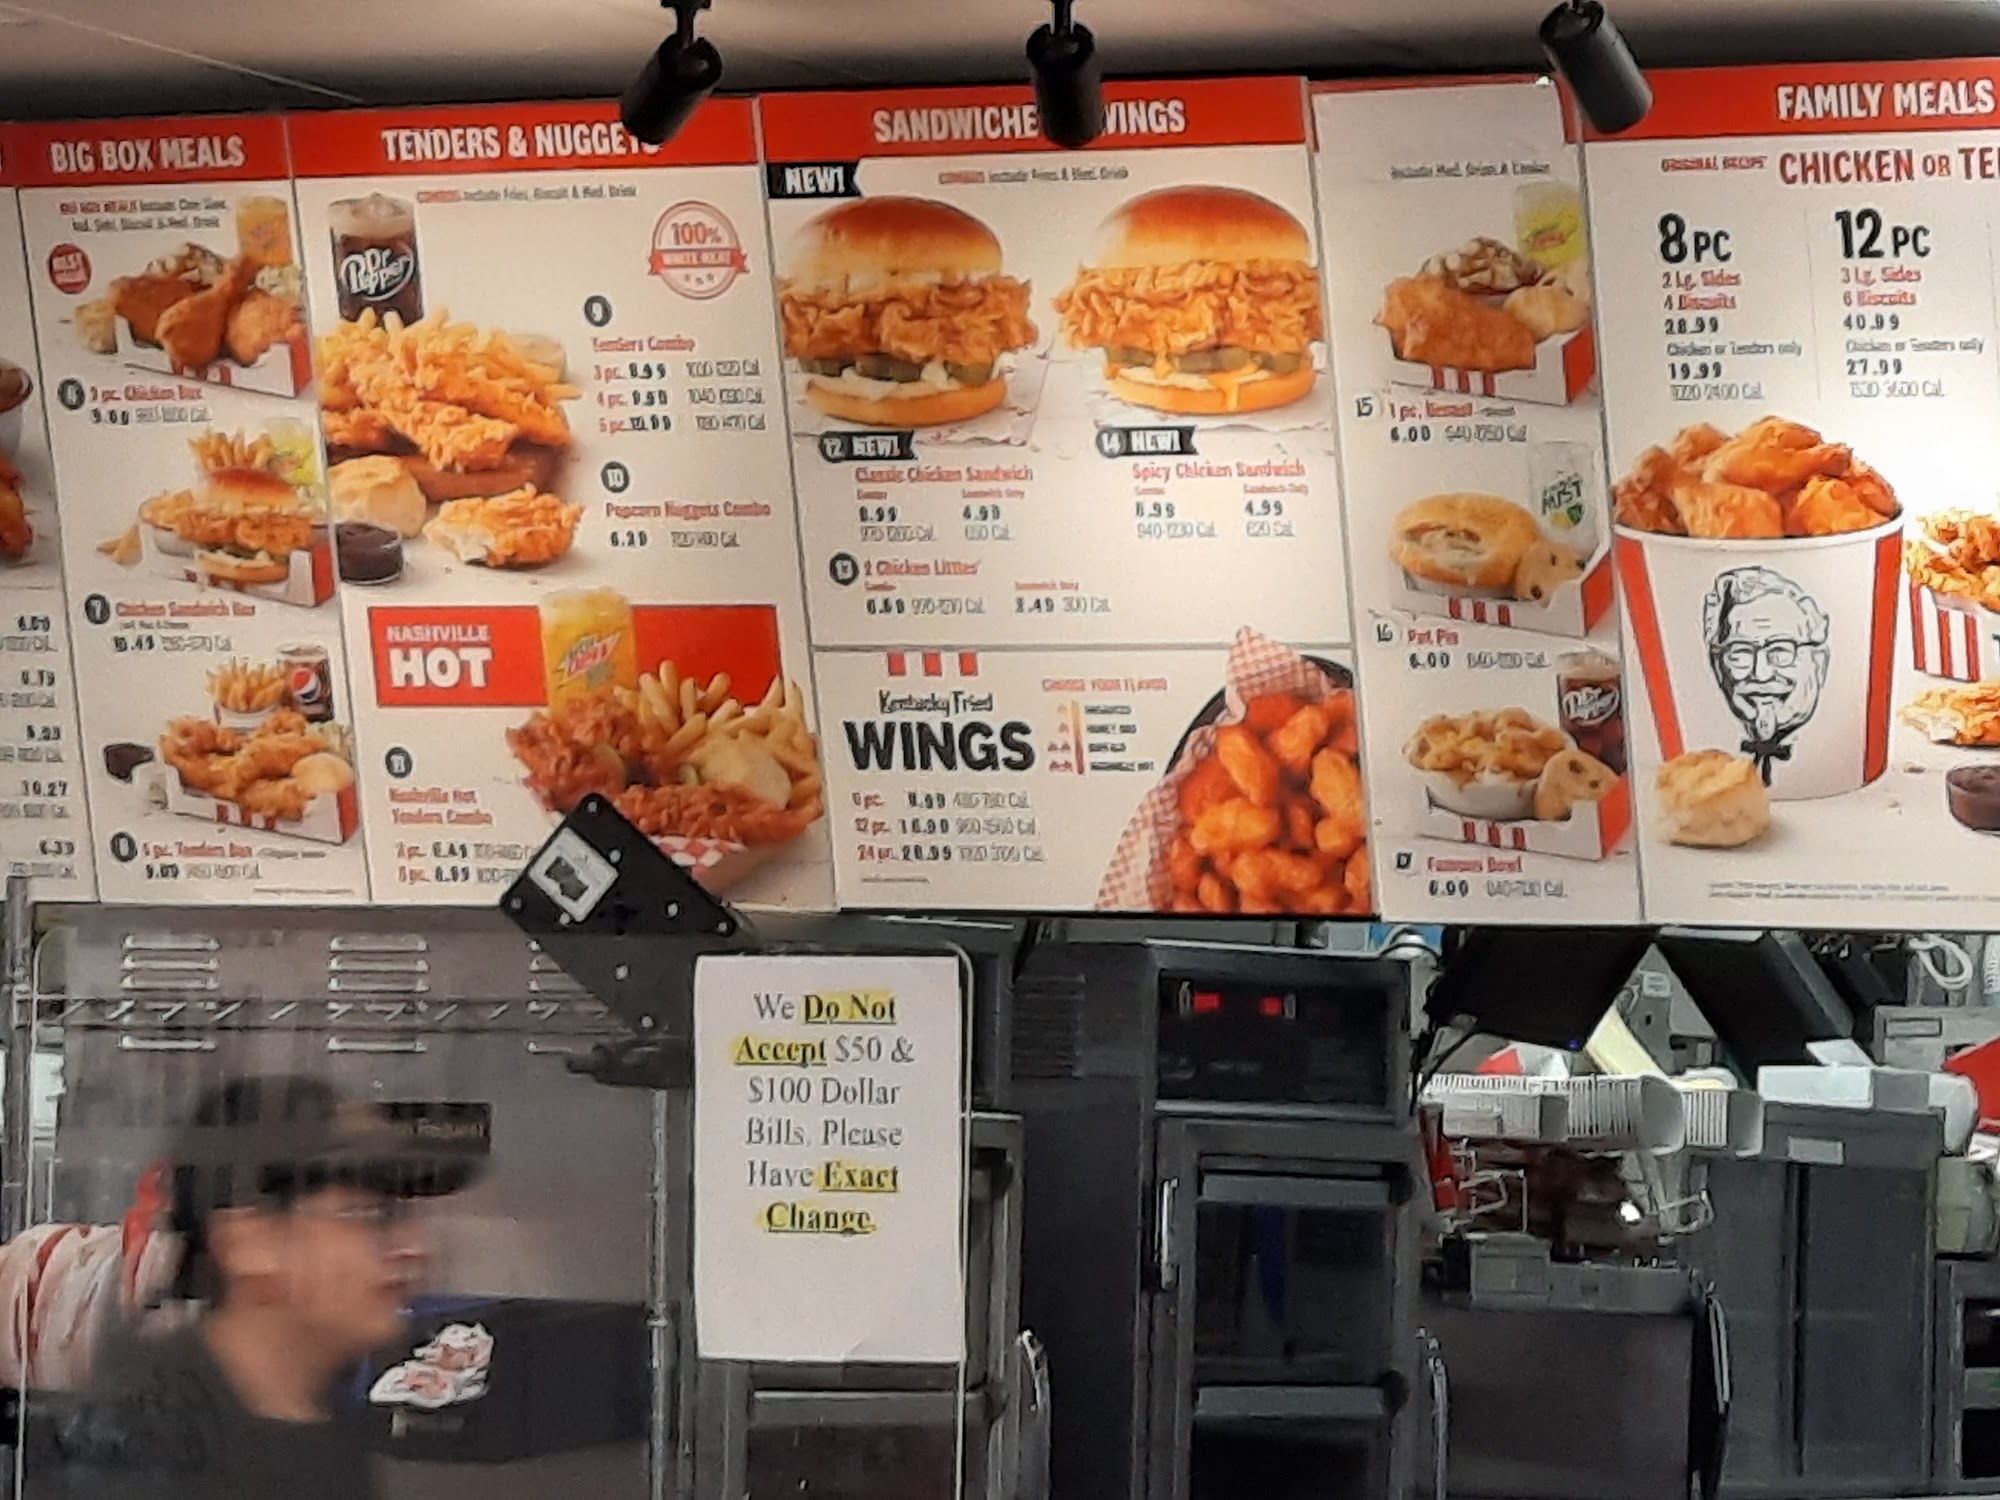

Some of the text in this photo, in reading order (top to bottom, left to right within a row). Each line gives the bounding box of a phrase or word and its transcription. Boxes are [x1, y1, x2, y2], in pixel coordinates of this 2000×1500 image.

[1776, 78, 1996, 120] FAMILY MEALS
[872, 105, 1039, 143] SANDWICHE
[51, 136, 245, 173] BIG BOX MEALS
[381, 126, 500, 161] TENDERS
[507, 124, 528, 158] &
[784, 166, 846, 195] NEW!
[1780, 150, 1915, 184] CHICKEN
[1923, 154, 1951, 176] OR
[671, 221, 722, 245] 100%
[1659, 213, 1732, 264] 8 PC
[1834, 208, 1931, 258] 12 PC
[1133, 462, 1170, 482] Spicy
[386, 625, 490, 642] NASHVILLE
[388, 646, 492, 689] HOT
[844, 721, 1035, 771] WINGS
[754, 992, 896, 1022] We Do Not
[735, 1035, 914, 1067] Accept $50 &
[748, 1076, 900, 1105] $100 Dollar
[822, 1118, 903, 1146] Please
[747, 1160, 899, 1190] Have Exact
